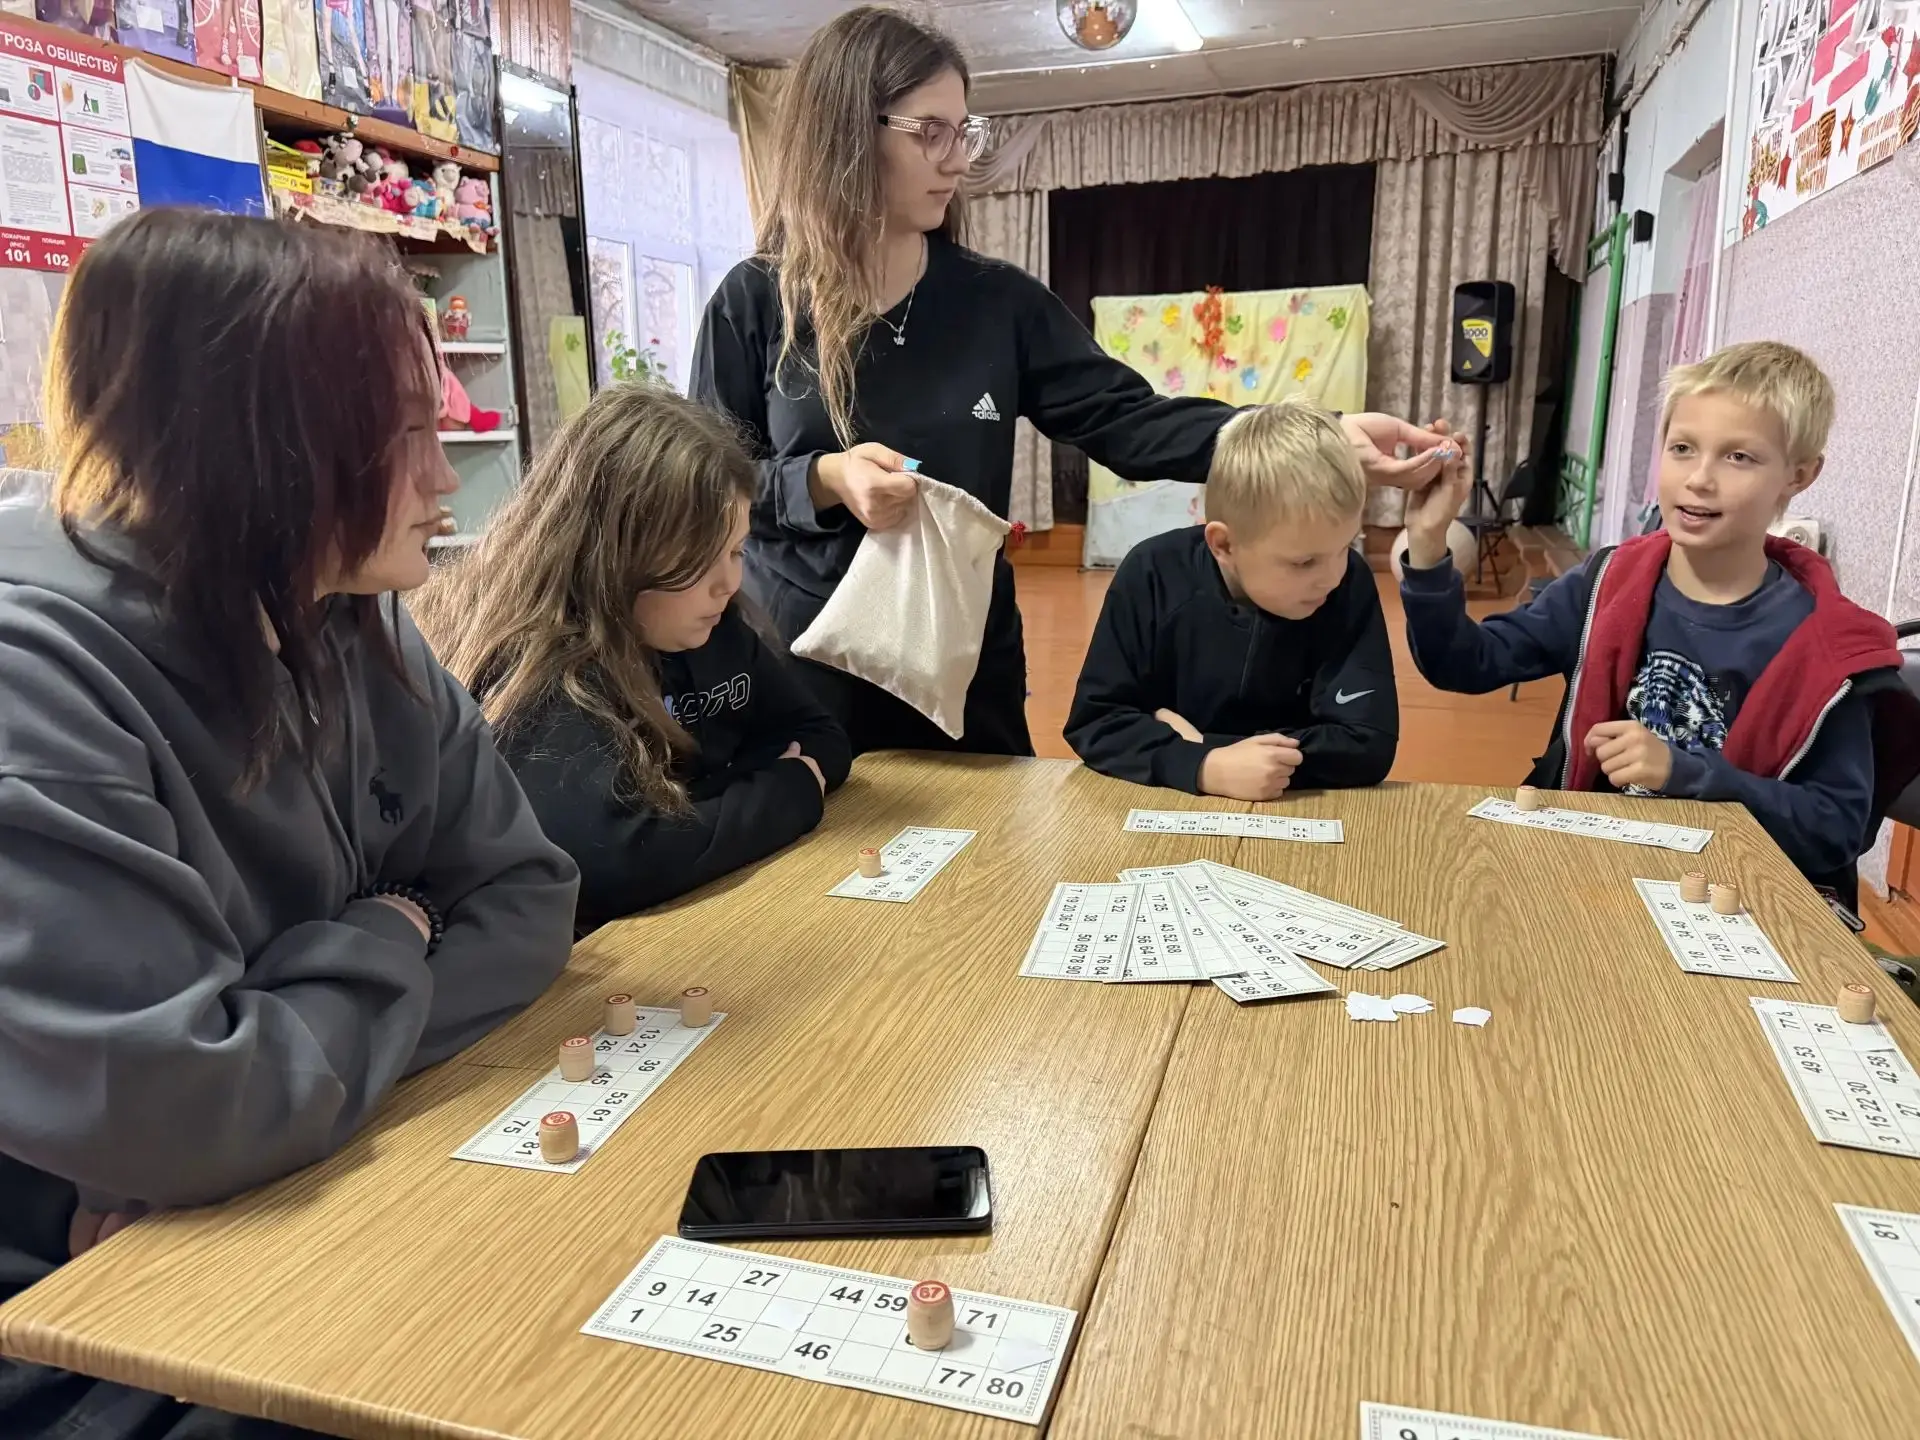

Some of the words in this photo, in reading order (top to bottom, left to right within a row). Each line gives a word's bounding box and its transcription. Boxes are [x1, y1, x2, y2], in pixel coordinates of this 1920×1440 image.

[46, 45, 118, 75] ОБЩЕСТВУ
[5, 248, 31, 263] 101
[44, 252, 70, 267] 102
[1066, 895, 1080, 904] 19
[1114, 895, 1128, 904] 15
[1063, 904, 1077, 913] 20
[1111, 904, 1126, 913] 22
[1154, 903, 1169, 912] 25
[1060, 913, 1074, 922] 36
[1055, 922, 1071, 932] 47
[1160, 922, 1175, 933] 43
[1275, 911, 1298, 920] 57
[1349, 933, 1372, 943] 87
[1077, 933, 1093, 943] 50
[1103, 934, 1119, 943] 54
[1136, 935, 1152, 944] 56
[1163, 933, 1178, 944] 52
[1228, 922, 1247, 933] 33
[1253, 944, 1272, 955] 52
[1266, 955, 1287, 965] 67
[1273, 933, 1294, 943] 67
[1298, 941, 1319, 951] 74
[1286, 926, 1308, 936] 65
[1311, 933, 1332, 944] 73
[1336, 941, 1358, 951] 80
[1073, 944, 1089, 953] 69
[1139, 945, 1155, 955] 64
[1166, 944, 1183, 954] 68
[1711, 942, 1731, 953] 23
[1069, 954, 1086, 964] 78
[1096, 954, 1113, 964] 76
[1143, 956, 1159, 966] 78
[1688, 950, 1707, 960] 18
[1718, 954, 1737, 963] 11
[1065, 965, 1082, 975] 90
[1093, 966, 1110, 976] 84
[1695, 962, 1713, 970] 3
[1253, 970, 1274, 981] 71
[1267, 982, 1288, 992] 80
[1779, 1018, 1801, 1030] 77
[1813, 1022, 1836, 1034] 76
[640, 1028, 660, 1040] 13
[595, 1039, 618, 1052] 26
[625, 1042, 647, 1054] 21
[1793, 1045, 1816, 1059] 53
[638, 1059, 661, 1073] 39
[1801, 1060, 1823, 1074] 49
[1866, 1055, 1891, 1068] 58
[591, 1072, 614, 1086] 45
[1876, 1070, 1900, 1084] 42
[1846, 1081, 1872, 1096] 30
[604, 1091, 629, 1105] 53
[1855, 1097, 1883, 1113] 22
[586, 1108, 612, 1123] 61
[1825, 1108, 1850, 1122] 12
[503, 1120, 531, 1134] 75
[1865, 1114, 1892, 1129] 15
[1878, 1135, 1901, 1144] 3
[514, 1141, 540, 1156] 81
[1868, 1221, 1900, 1241] 81
[647, 1281, 667, 1297] 9
[686, 1289, 718, 1307] 14
[919, 1287, 942, 1299] 67
[743, 1270, 781, 1287] 27
[829, 1286, 865, 1304] 44
[873, 1294, 908, 1312] 59
[966, 1309, 999, 1329] 71
[630, 1308, 645, 1324] 1
[702, 1323, 742, 1343] 25
[794, 1341, 832, 1361] 46
[938, 1367, 976, 1388] 77
[986, 1377, 1025, 1399] 80
